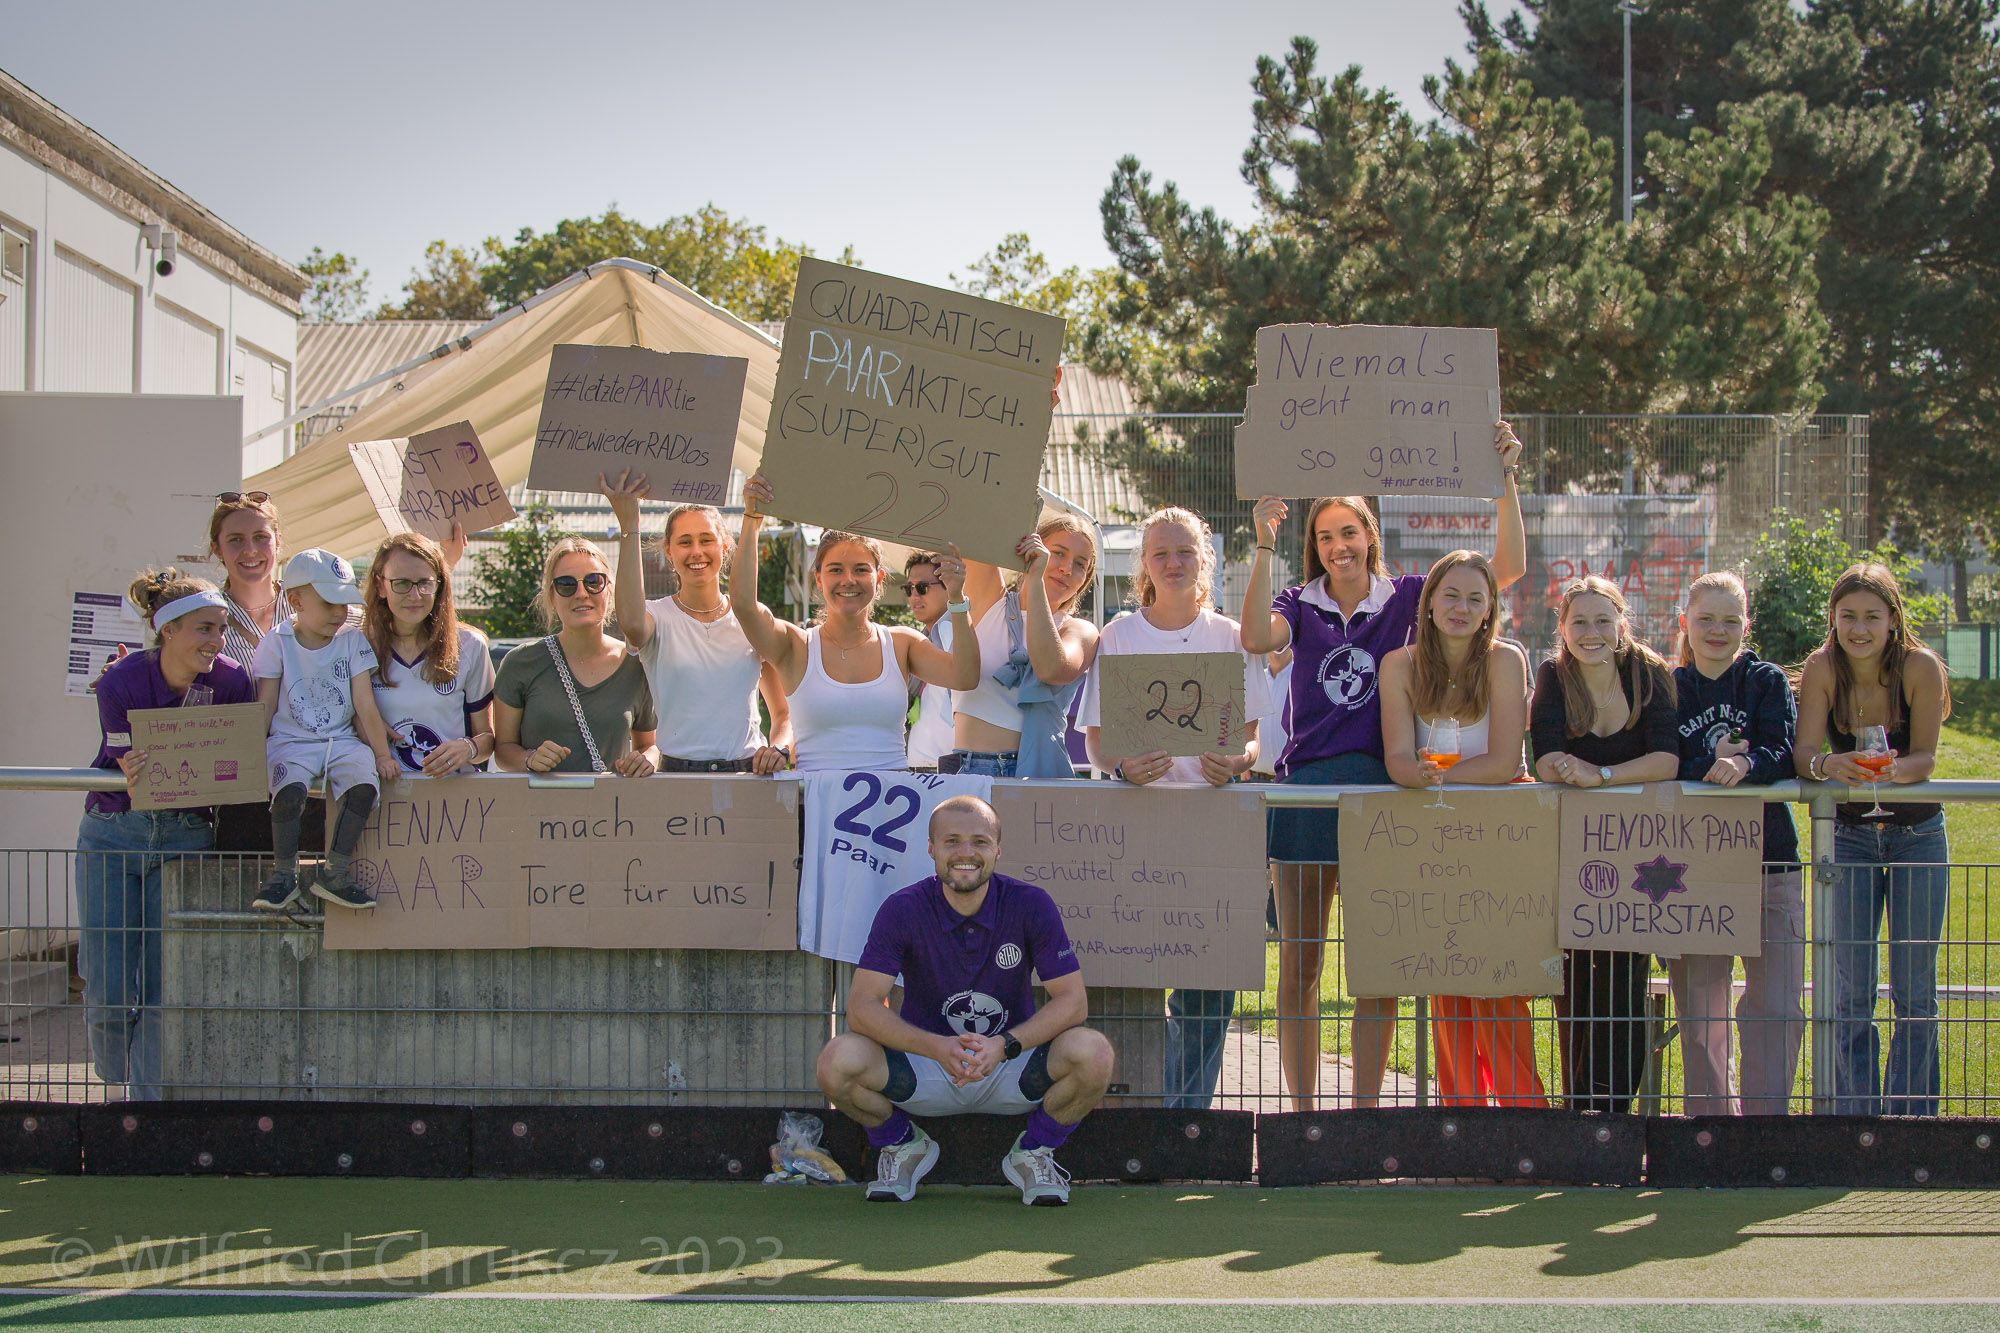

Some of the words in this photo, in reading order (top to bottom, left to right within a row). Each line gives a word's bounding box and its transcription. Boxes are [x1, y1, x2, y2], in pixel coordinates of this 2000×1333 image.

[810, 279, 1041, 363] QUADRATISCH.
[1276, 332, 1455, 380] Niemals
[551, 372, 697, 411] #letztePAARtie
[803, 330, 1024, 427] PAARAKTISCH.
[1280, 384, 1351, 430] geht
[1390, 398, 1450, 417] man
[538, 420, 710, 467] #niewiederRADlos
[780, 387, 1001, 486] (SUPER)GUT.
[1297, 449, 1336, 471] so
[671, 479, 722, 501] #HP22
[844, 471, 950, 546] 22
[1145, 679, 1203, 732] 22
[1679, 706, 1716, 738] GANT
[355, 797, 496, 852] HENNY
[539, 796, 634, 840] mach
[666, 812, 725, 836] ein
[833, 772, 921, 853] 22
[1034, 801, 1125, 860] Henny
[1364, 810, 1419, 852] Ab
[1431, 819, 1485, 853] jetzt
[1497, 823, 1537, 841] nur
[1583, 811, 1696, 853] HENDRIK
[1701, 813, 1762, 853] PAAR
[830, 838, 896, 875] Paar
[1023, 859, 1116, 883] schüttel
[1131, 860, 1187, 888] dein
[1419, 858, 1472, 878] noch
[349, 854, 485, 917] PAAR
[520, 865, 585, 906] Tore
[623, 858, 669, 905] für
[1583, 864, 1616, 893] BTHV
[1055, 904, 1093, 920] aar
[1111, 894, 1144, 924] für
[1370, 887, 1555, 937] SPIELERMANN
[1572, 901, 1735, 938] SUPERSTAR
[998, 945, 1019, 967] BTHV
[1443, 929, 1459, 950] &
[1390, 952, 1487, 981] FANBOY
